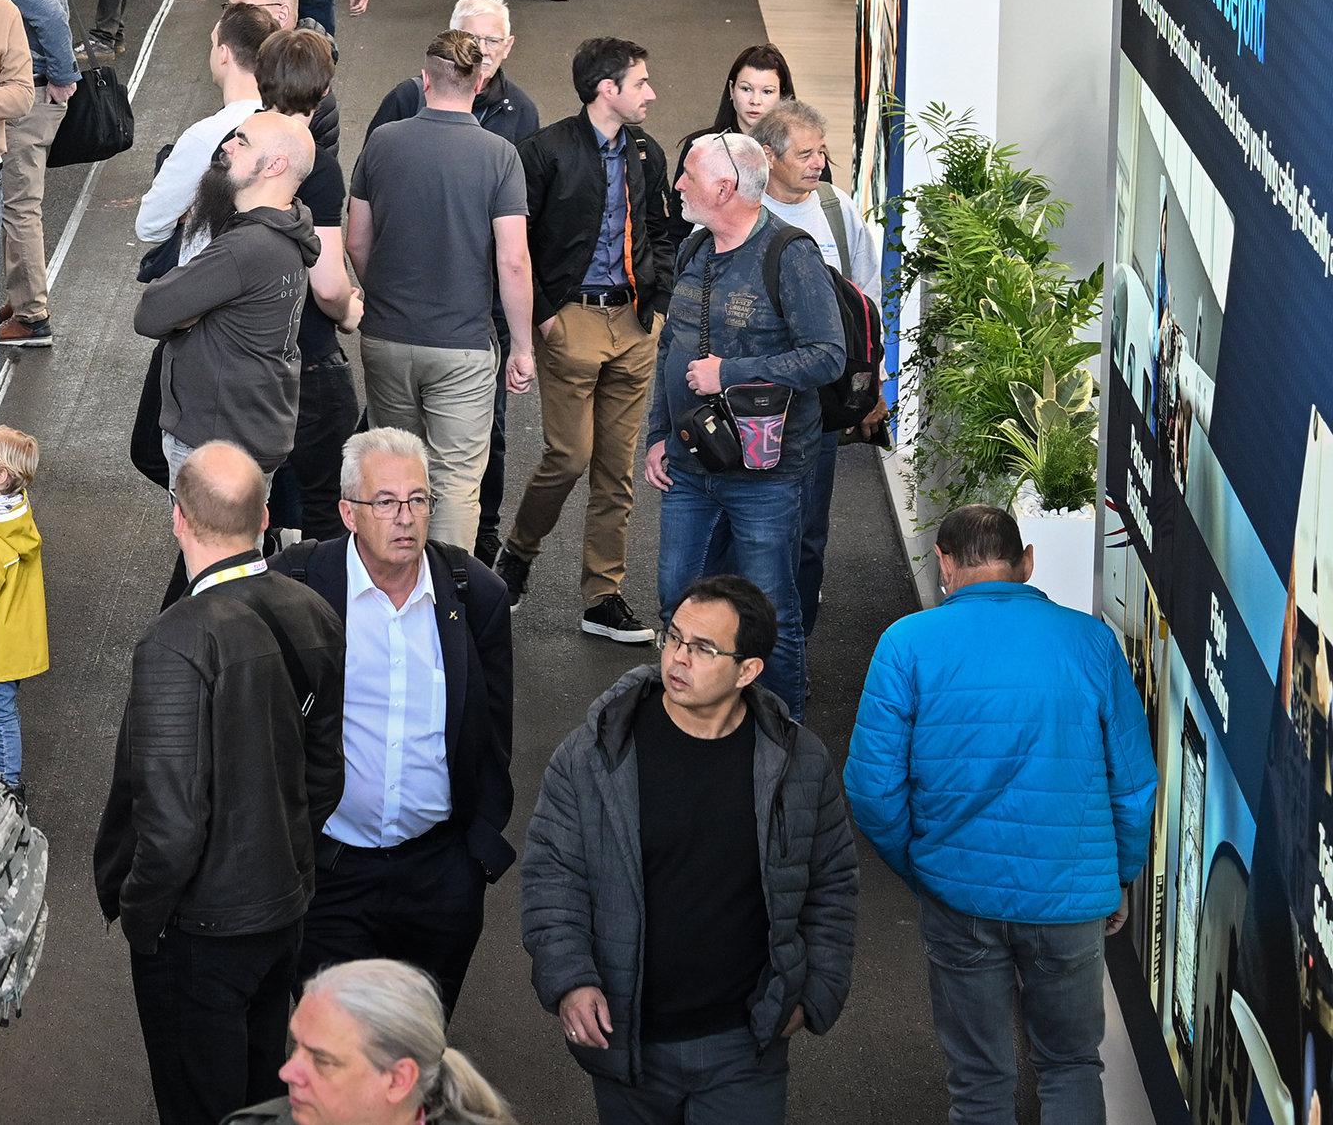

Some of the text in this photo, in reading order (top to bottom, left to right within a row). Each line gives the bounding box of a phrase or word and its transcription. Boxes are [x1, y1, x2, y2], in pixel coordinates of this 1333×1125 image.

[1156, 1, 1169, 40] your
[1168, 16, 1191, 72] operation
[1190, 40, 1202, 87] with
[1201, 55, 1225, 120] solutions
[1224, 82, 1236, 136] that
[1235, 94, 1250, 164] keep
[1249, 127, 1261, 172] you
[1261, 130, 1279, 206] flying
[1278, 162, 1298, 231] safely,
[1298, 185, 1331, 278] efficiently
[1131, 423, 1152, 497] Parts and
[1210, 591, 1227, 660] Flight
[1205, 639, 1229, 734] Planning
